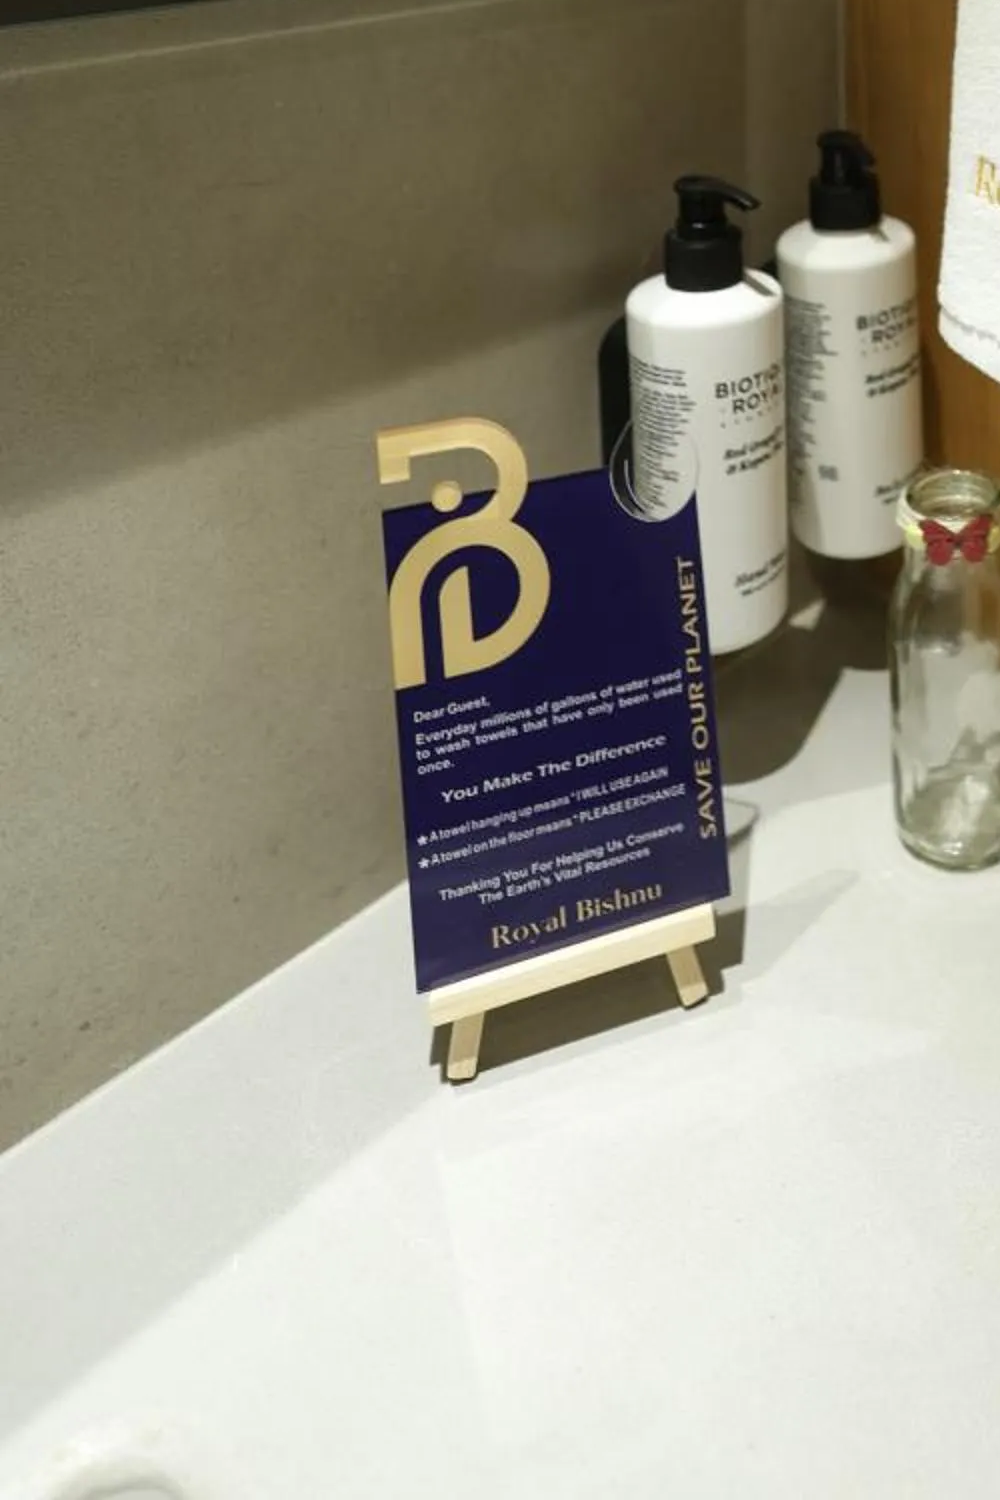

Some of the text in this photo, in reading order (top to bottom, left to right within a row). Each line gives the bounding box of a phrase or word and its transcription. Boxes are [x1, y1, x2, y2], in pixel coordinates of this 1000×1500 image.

[413, 707, 445, 723] Dear
[415, 668, 682, 745] Everyday millions of gallons of water used
[416, 682, 683, 760] to wash towels that have only been used
[676, 555, 717, 839] SAVE OUR PLANET
[417, 759, 456, 775] once.
[441, 734, 667, 803] You Make The Difference
[438, 820, 471, 840] towel
[438, 821, 685, 901] Thanking You For Helping Us Conserve
[440, 843, 473, 863] towel
[473, 840, 489, 854] on
[488, 835, 508, 849] the
[478, 889, 505, 905] The
[553, 864, 582, 882] Vital
[584, 846, 651, 873] Resources
[491, 883, 663, 949] Royal Bishnu
